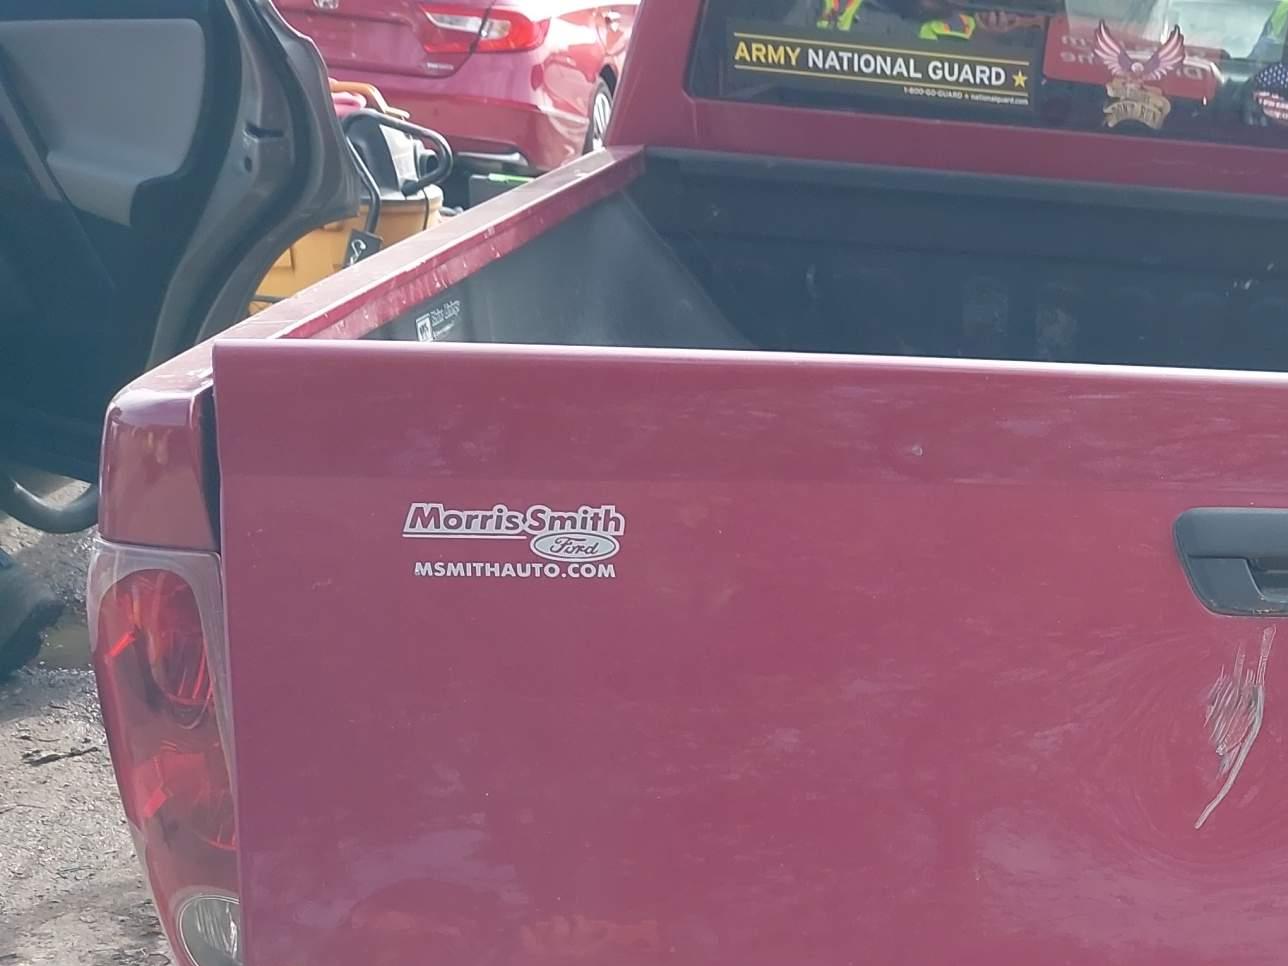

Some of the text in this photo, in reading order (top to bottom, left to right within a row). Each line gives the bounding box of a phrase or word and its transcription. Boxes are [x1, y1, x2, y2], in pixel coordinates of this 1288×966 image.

[734, 41, 1006, 87] ARMY NATIONAL GUARD
[403, 502, 625, 535] Morris Smith
[550, 536, 600, 556] Ford
[414, 561, 616, 578] MSMITHAUTO.COM
